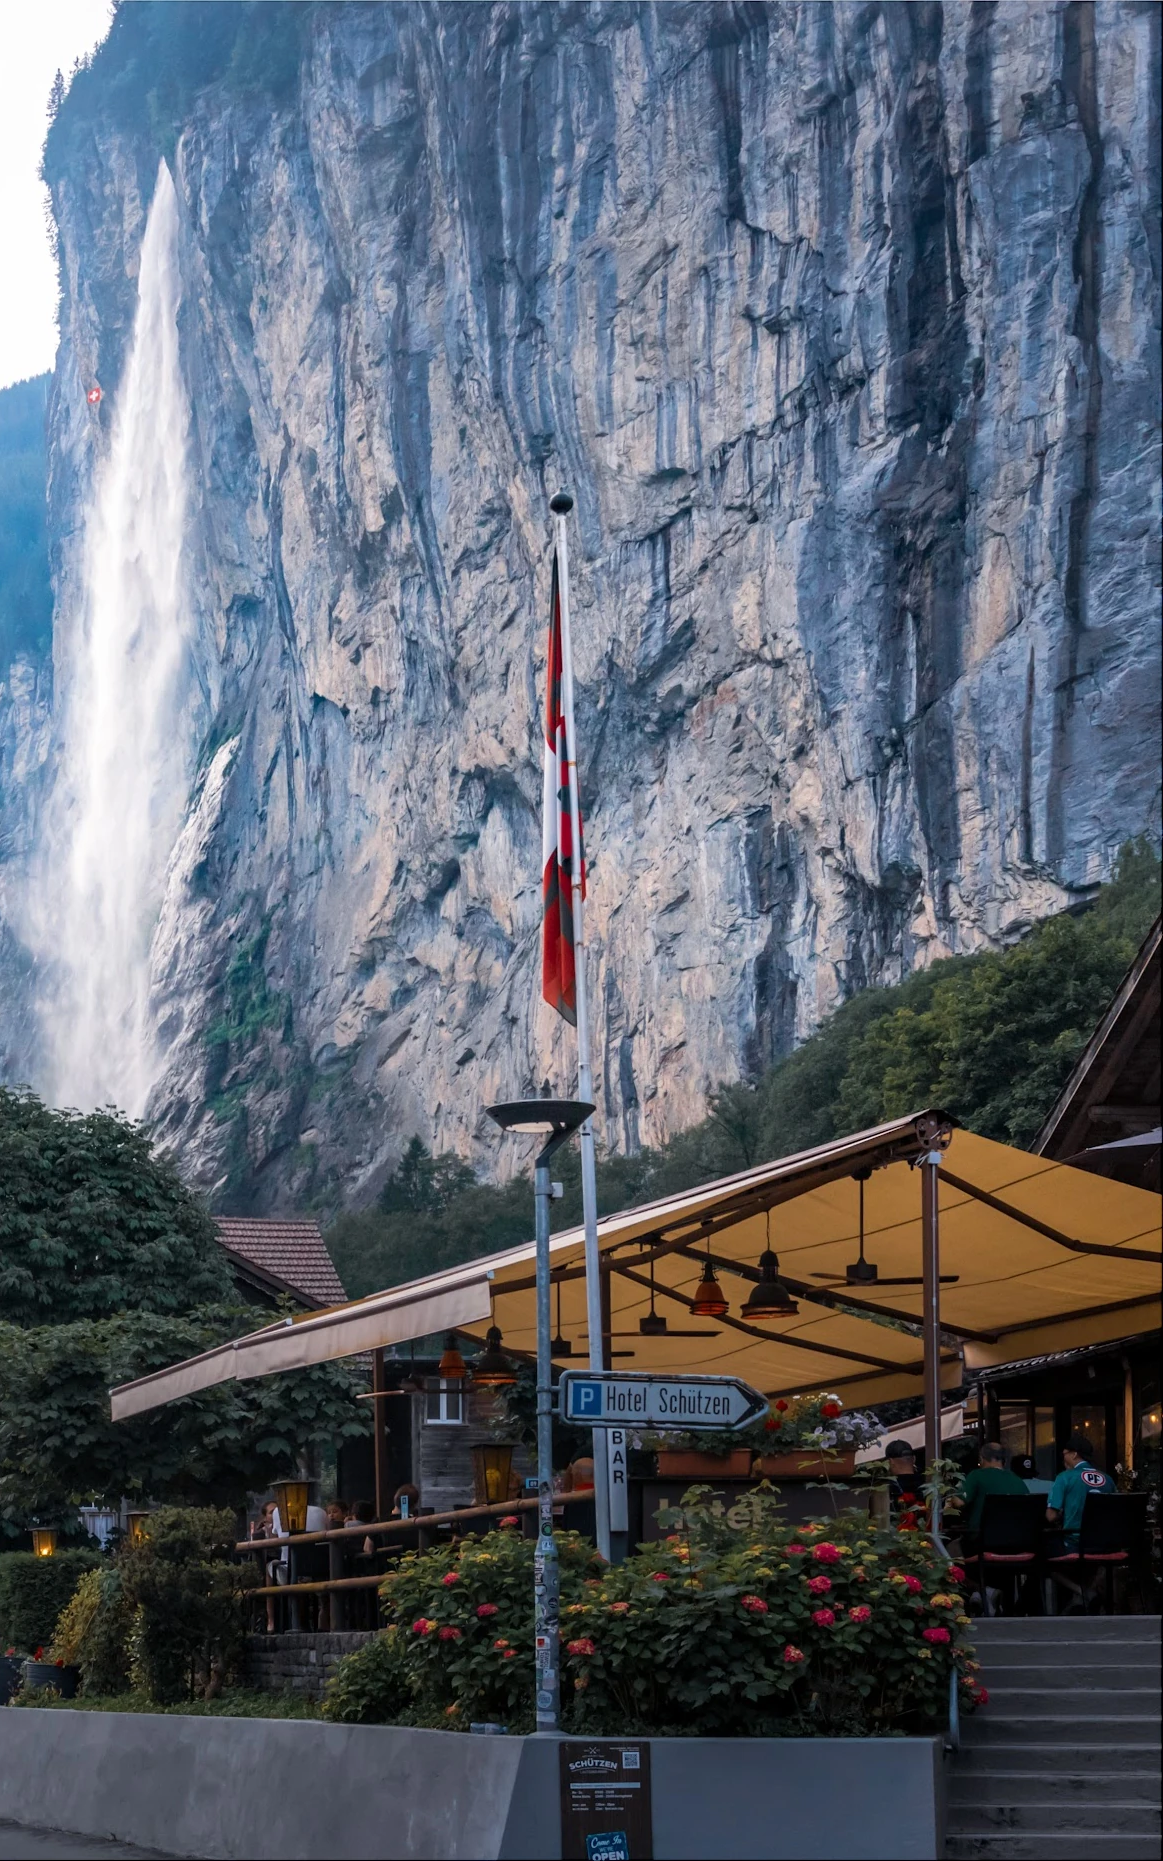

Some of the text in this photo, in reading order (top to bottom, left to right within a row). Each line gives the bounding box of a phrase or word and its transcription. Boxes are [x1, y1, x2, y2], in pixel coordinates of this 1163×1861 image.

[580, 1385, 730, 1416] P Hotel Schützen
[611, 1430, 624, 1484] BAR
[1087, 1473, 1100, 1484] PF
[658, 1497, 763, 1530] htel
[568, 1757, 618, 1771] SCHÜTZEN
[592, 1850, 625, 1861] OPEN
